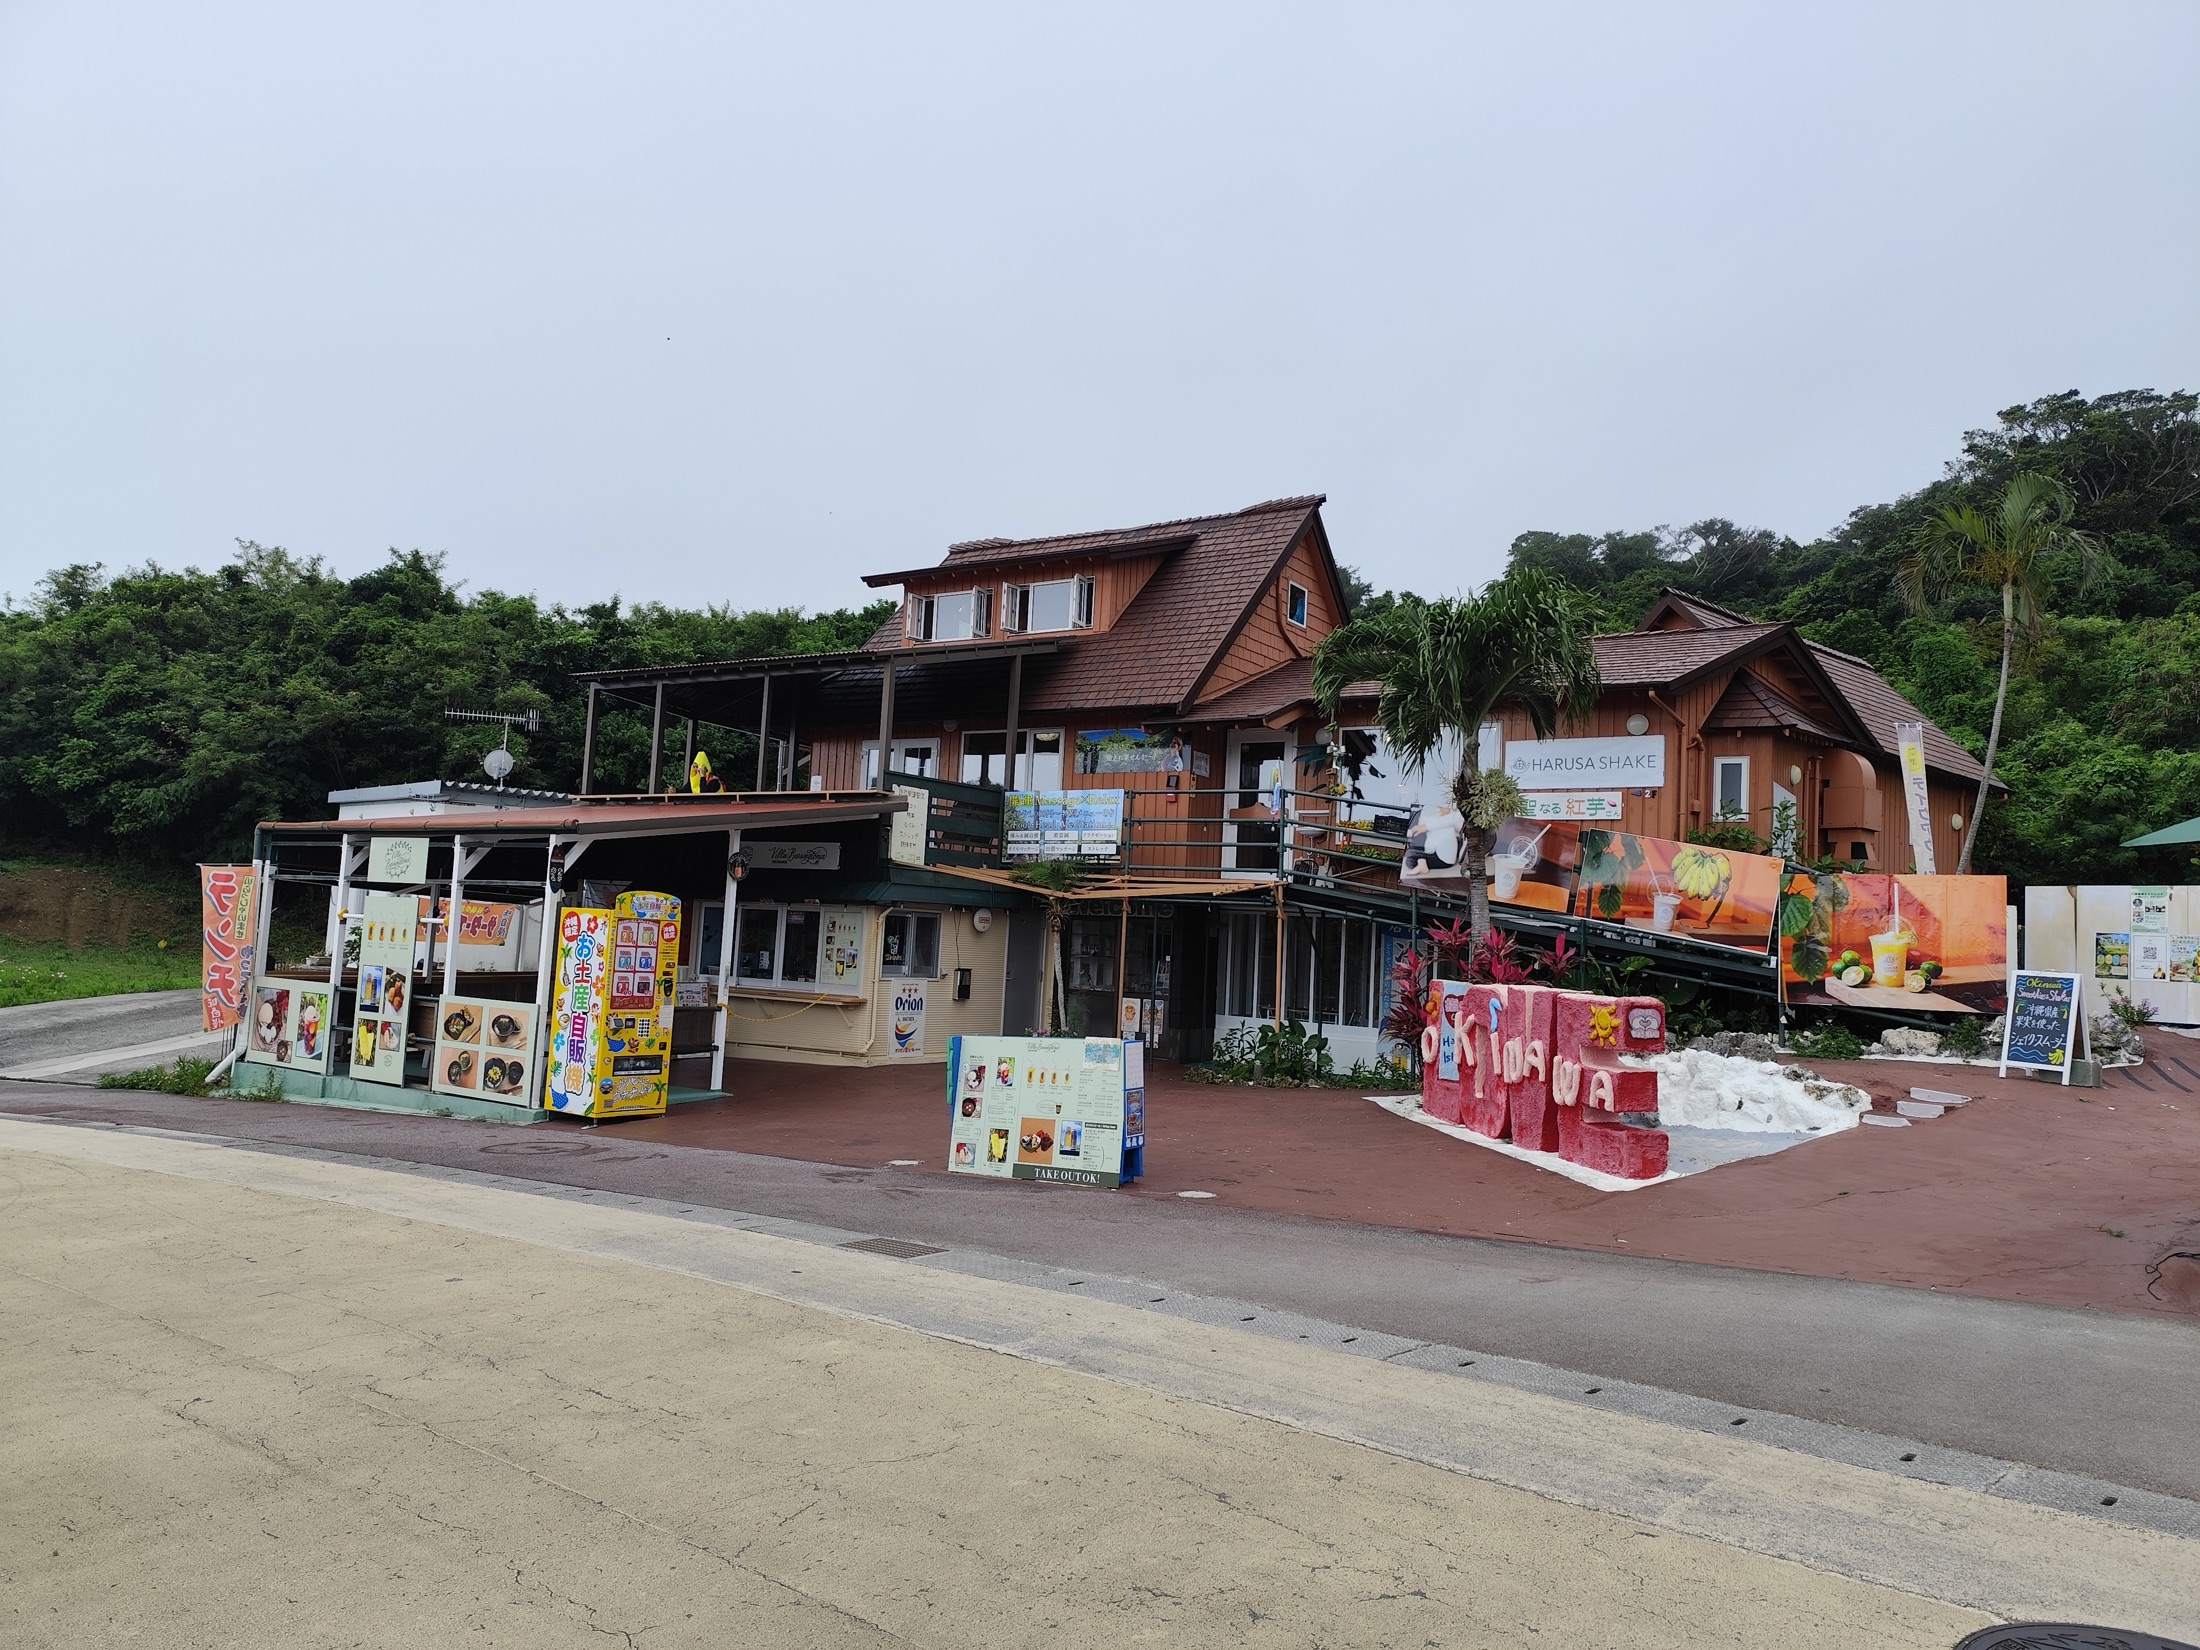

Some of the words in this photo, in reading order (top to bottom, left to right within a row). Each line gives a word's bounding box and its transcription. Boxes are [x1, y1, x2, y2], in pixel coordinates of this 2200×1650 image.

[1532, 757, 1596, 772] HARUSA
[1599, 754, 1657, 770] SHAKE
[1644, 789, 1658, 799] 2F
[563, 912, 579, 927] 沖縄
[564, 926, 579, 938] 限定
[894, 993, 924, 1011] Orion
[564, 931, 596, 1095] お土産自販機
[2024, 1003, 2060, 1018] 沖縄県産
[2014, 1016, 2061, 1031] 果実を使った
[1034, 1167, 1060, 1180] TAKE
[1060, 1170, 1082, 1182] OUT
[1082, 1173, 1101, 1185] OK!
